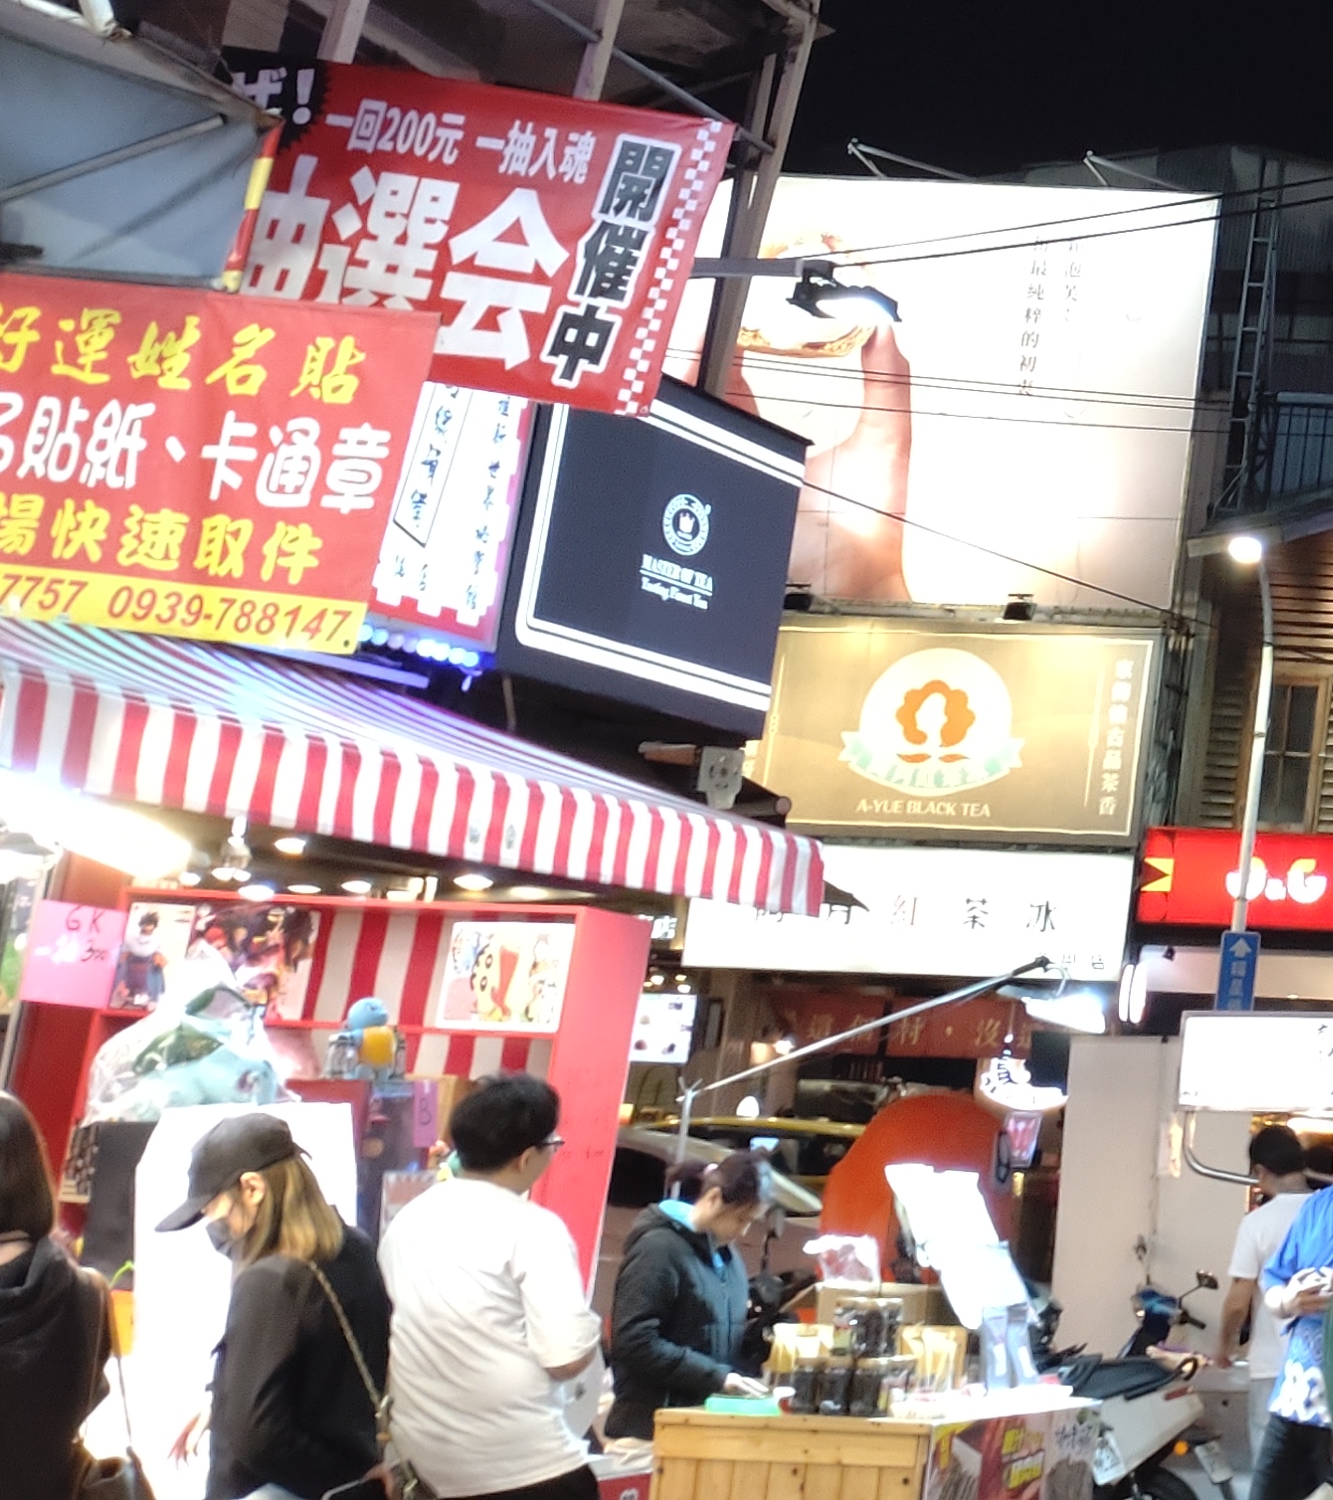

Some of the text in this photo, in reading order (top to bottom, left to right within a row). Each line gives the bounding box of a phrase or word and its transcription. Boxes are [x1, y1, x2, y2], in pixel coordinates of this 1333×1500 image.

[325, 98, 597, 185] 一回200元 一抽入魂
[540, 133, 682, 388] 開催中
[107, 584, 352, 642] 0939-788147
[855, 798, 991, 818] A-YUE BLACK TEA
